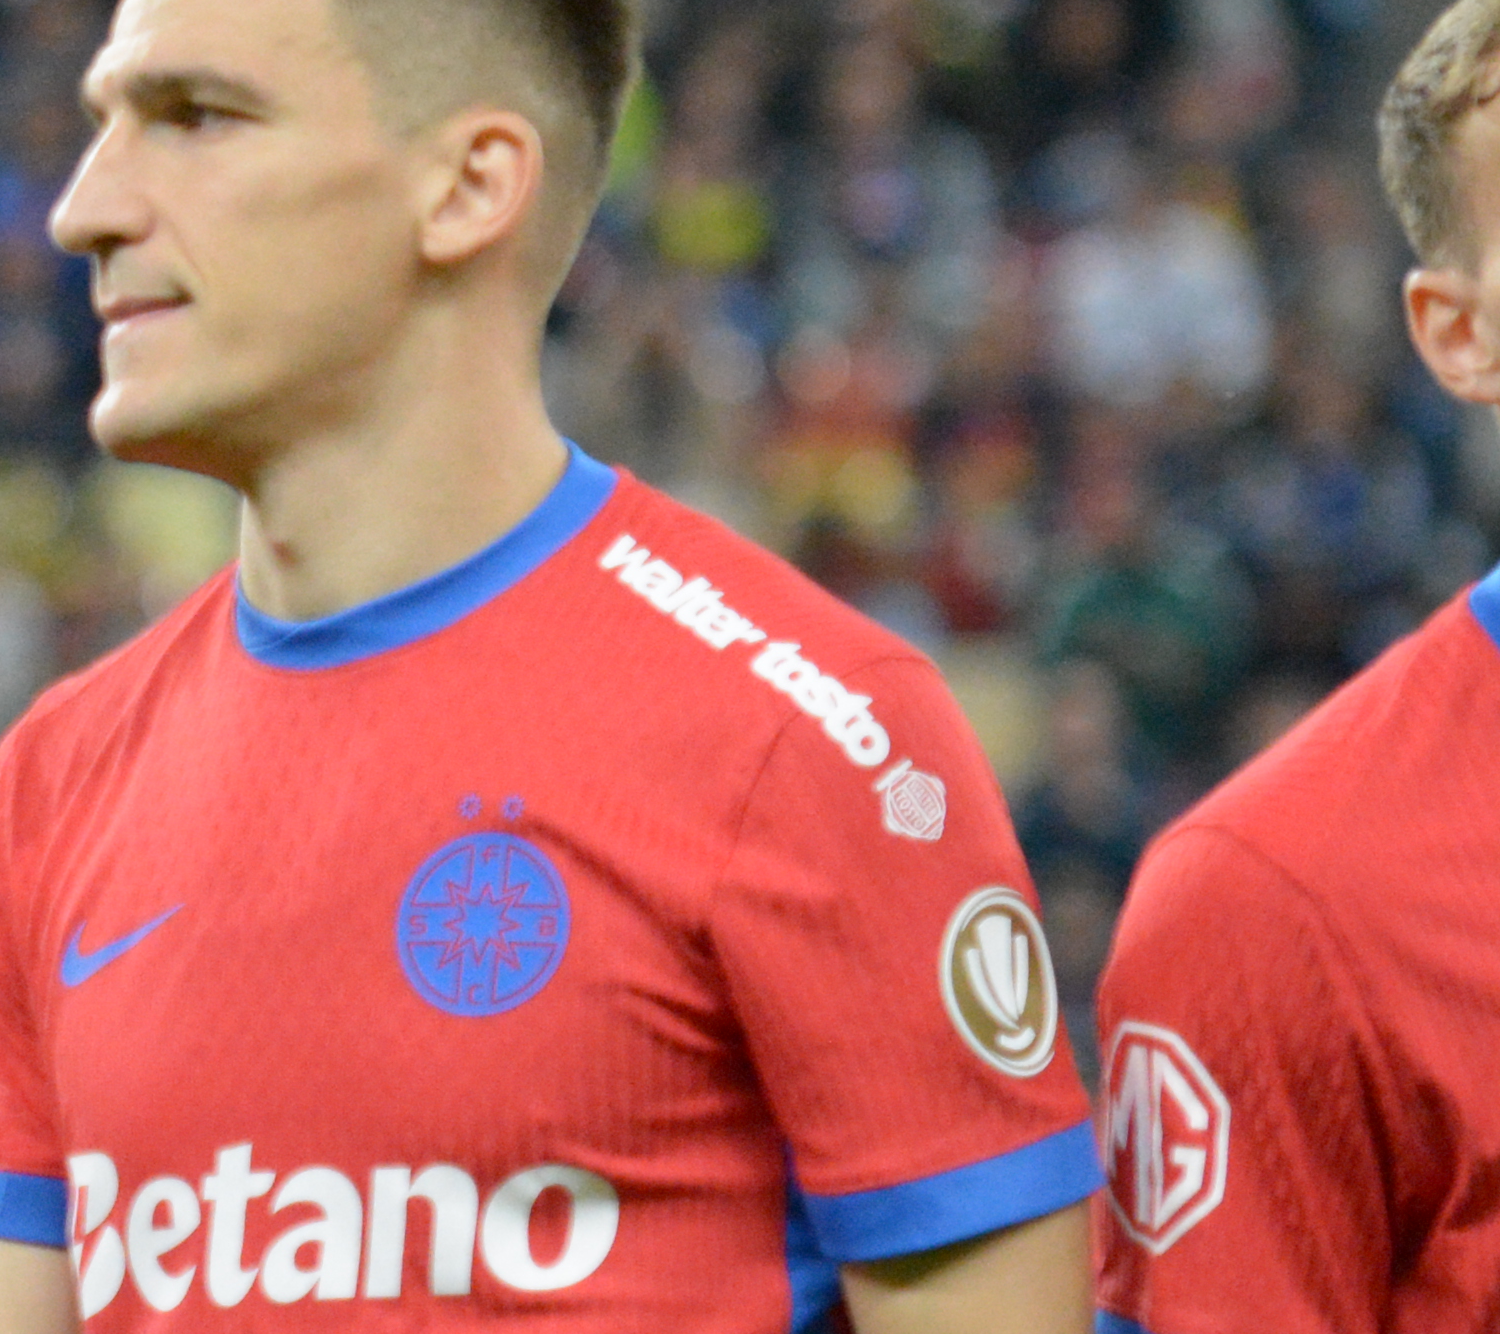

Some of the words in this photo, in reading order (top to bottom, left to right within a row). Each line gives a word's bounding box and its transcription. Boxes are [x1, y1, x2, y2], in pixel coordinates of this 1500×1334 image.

[599, 533, 768, 650] walter
[749, 640, 891, 767] tosto
[68, 1141, 619, 1321] Betano
[1112, 1043, 1209, 1233] MG
